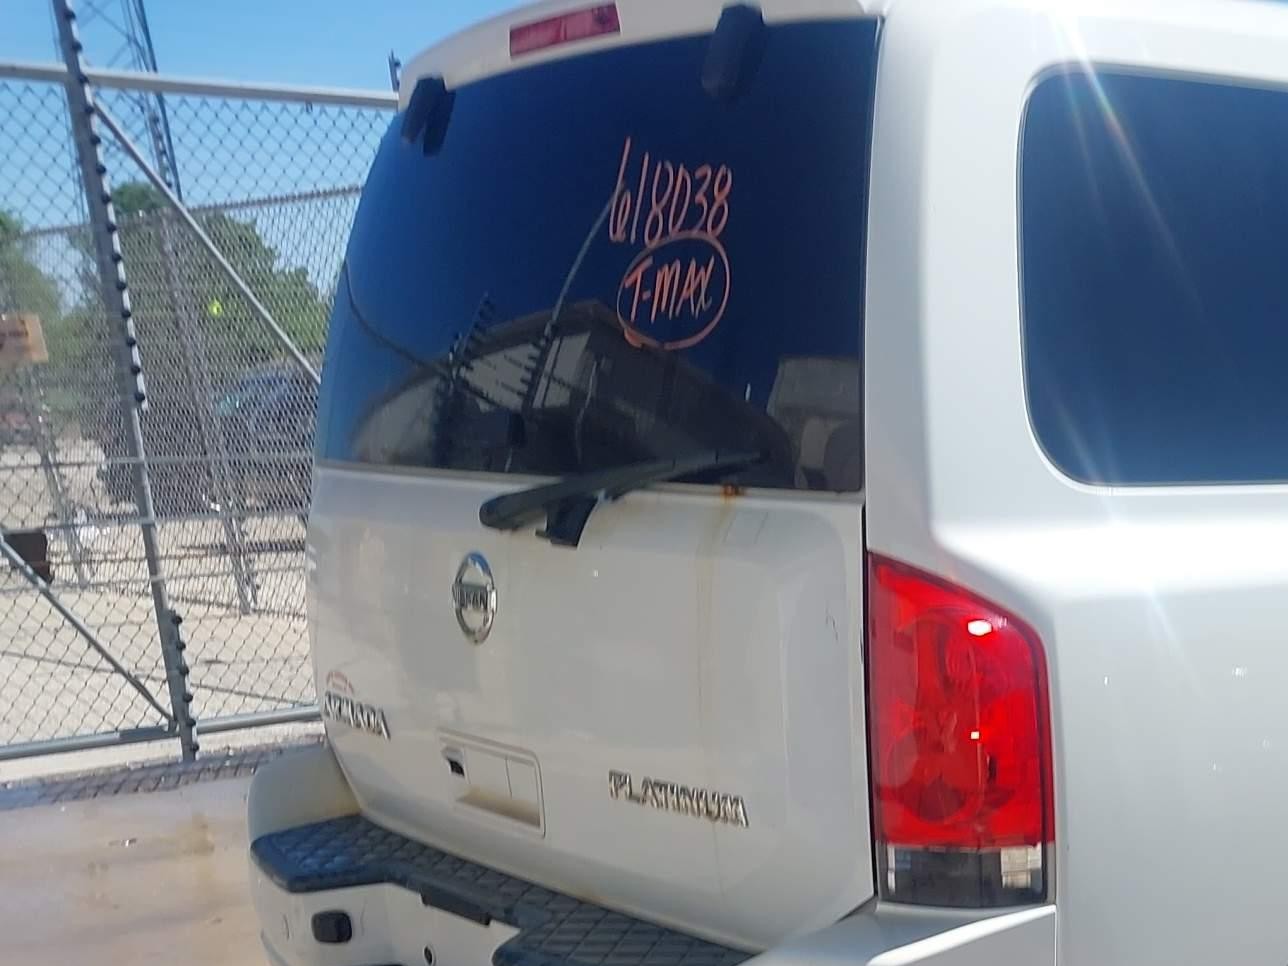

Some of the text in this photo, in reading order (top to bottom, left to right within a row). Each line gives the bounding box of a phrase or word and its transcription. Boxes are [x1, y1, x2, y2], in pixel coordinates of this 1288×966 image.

[608, 136, 732, 247] 618038
[623, 255, 715, 324] T-MAX
[608, 769, 749, 828] PLATINUM
